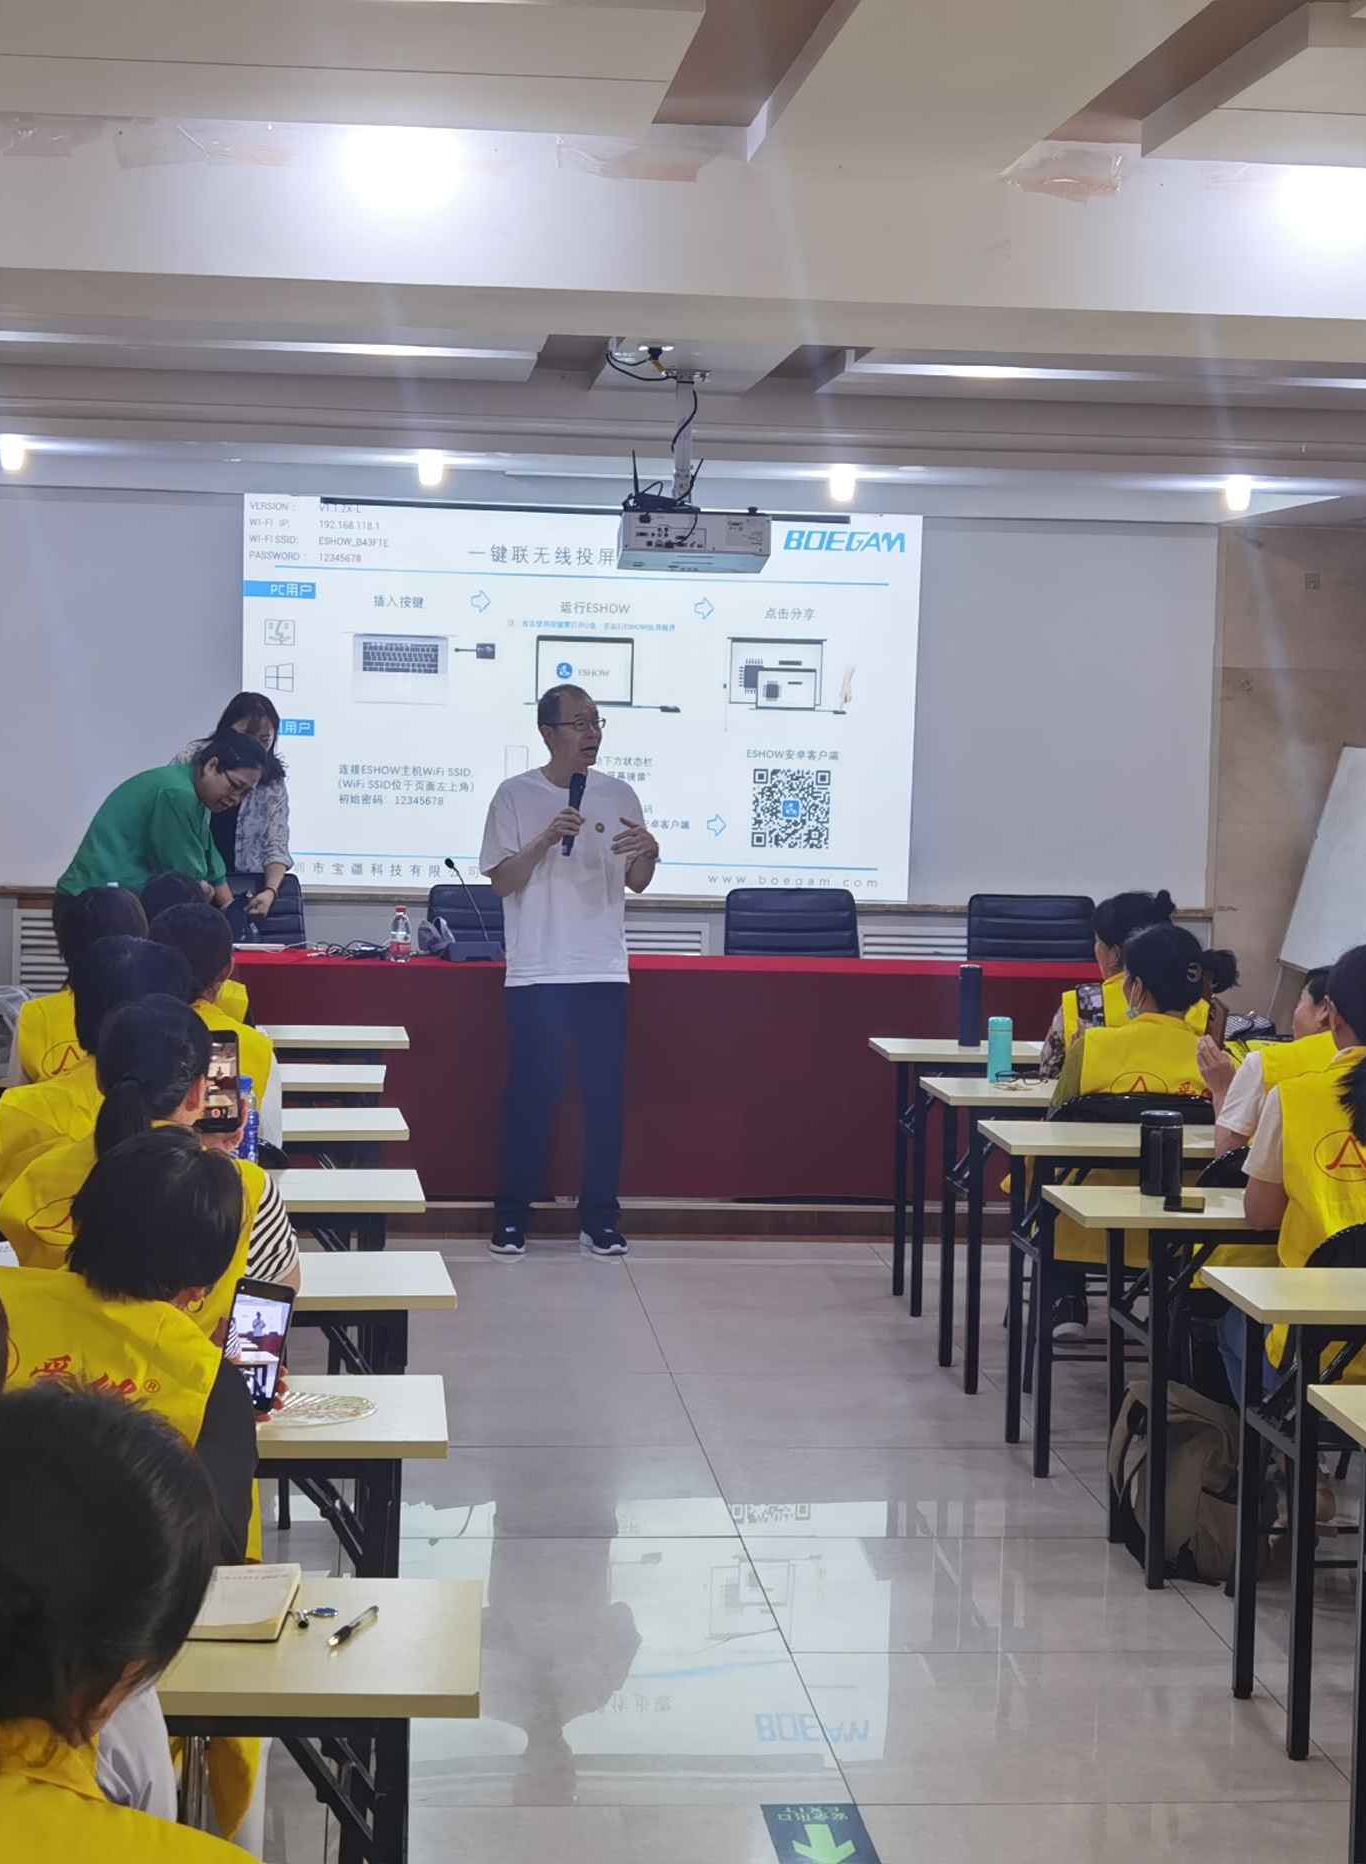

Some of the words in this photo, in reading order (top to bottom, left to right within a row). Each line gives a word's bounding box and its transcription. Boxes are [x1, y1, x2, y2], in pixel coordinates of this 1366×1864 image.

[250, 502, 289, 511] VERSION
[319, 520, 380, 531] 192.168.118.1
[318, 537, 389, 548] ESHOW_B43F1E
[783, 530, 906, 553] BOEGAM
[249, 551, 300, 560] PASSWORD
[319, 553, 362, 563] 12345678
[269, 584, 313, 597] PC用户
[373, 595, 425, 609] 插入按键
[560, 601, 631, 614] 运行ESHOW
[764, 607, 816, 621] 点击分享
[578, 669, 611, 678] ESHOW
[746, 749, 839, 761] ESHOW安卓客户端
